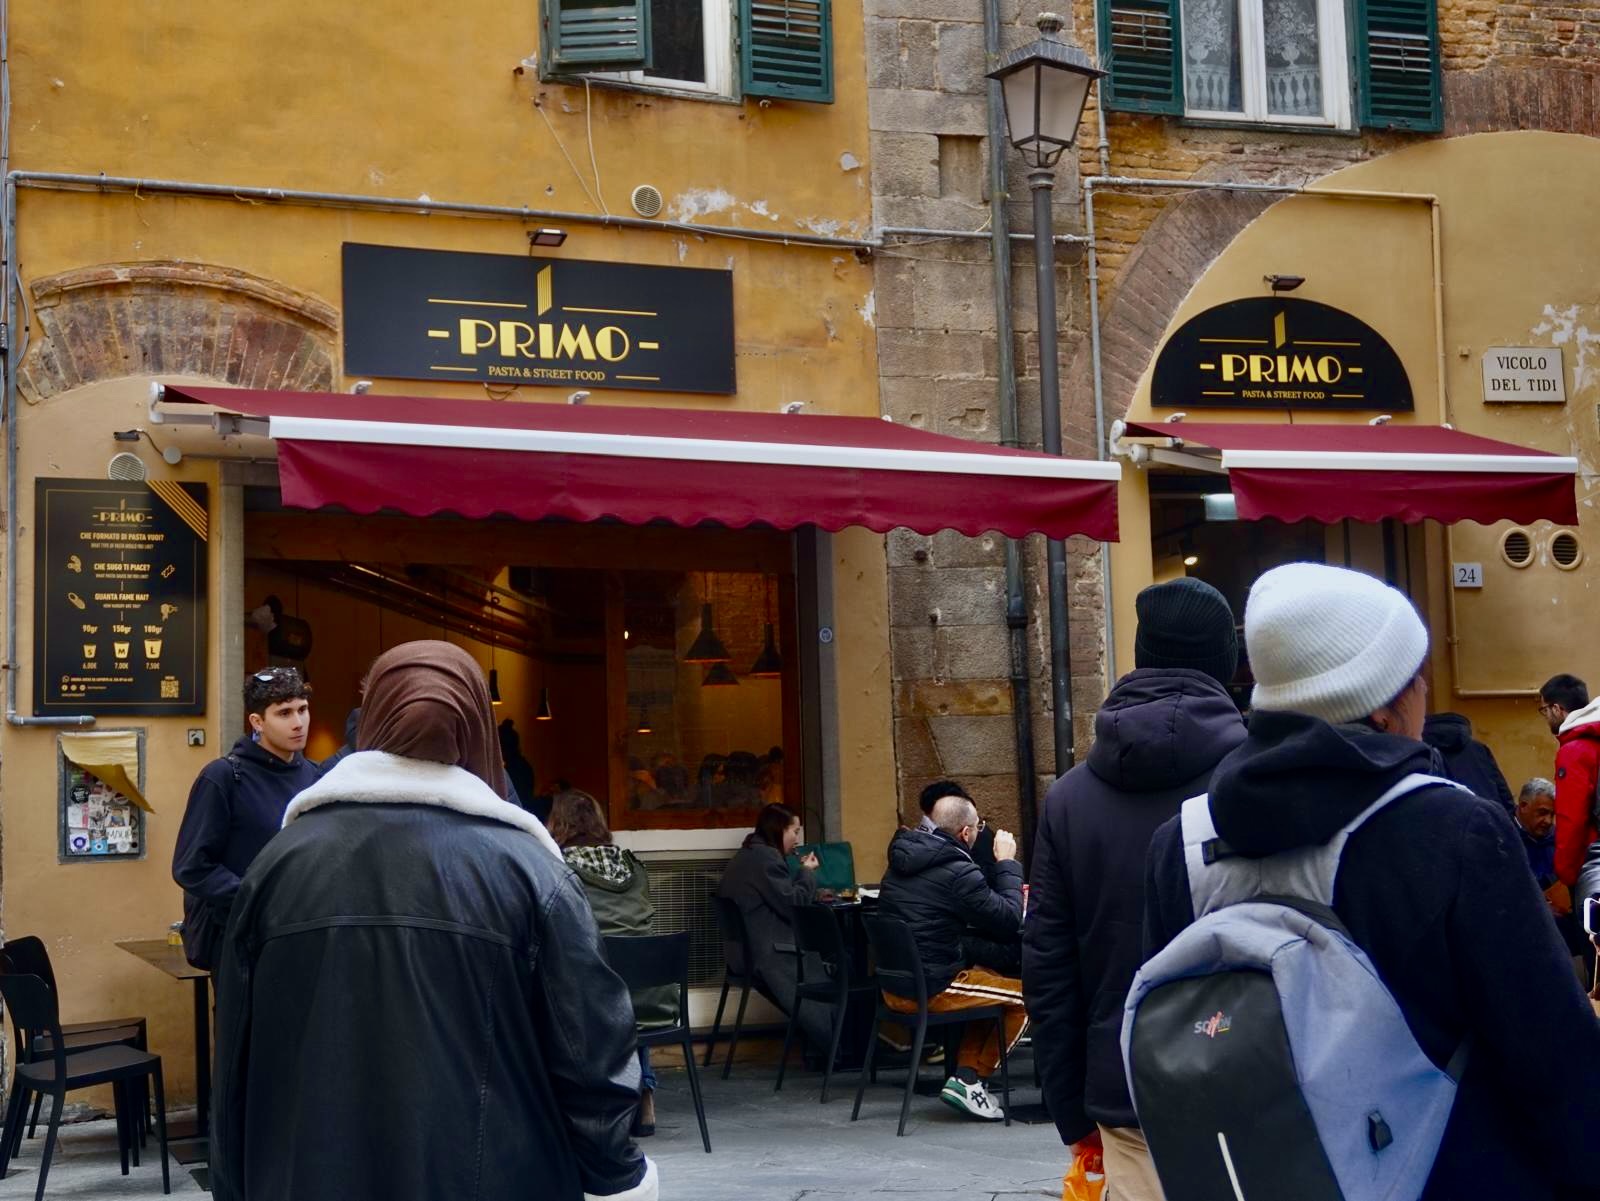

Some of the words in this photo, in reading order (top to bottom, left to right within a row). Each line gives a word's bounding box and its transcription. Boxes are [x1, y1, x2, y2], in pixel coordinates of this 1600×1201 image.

[459, 318, 630, 362] PRIMO
[1222, 354, 1342, 383] PRIMO
[1496, 356, 1547, 370] VICOLO
[488, 366, 522, 378] PASTA
[524, 368, 532, 377] &
[533, 368, 572, 380] STREET
[575, 370, 605, 381] FOOD
[1491, 378, 1520, 391] DEL
[1528, 379, 1556, 392] TIDI
[1242, 390, 1266, 398] PASTA
[1273, 391, 1302, 399] STREET
[1303, 392, 1325, 400] FOOD
[100, 512, 145, 522] PRIMO
[80, 532, 92, 540] CHE
[92, 532, 120, 540] FORMATO
[120, 532, 127, 540] DI
[128, 532, 146, 541] PASTA
[147, 534, 164, 542] VUOI?
[1458, 568, 1476, 583] 24
[112, 625, 132, 634] 150gr
